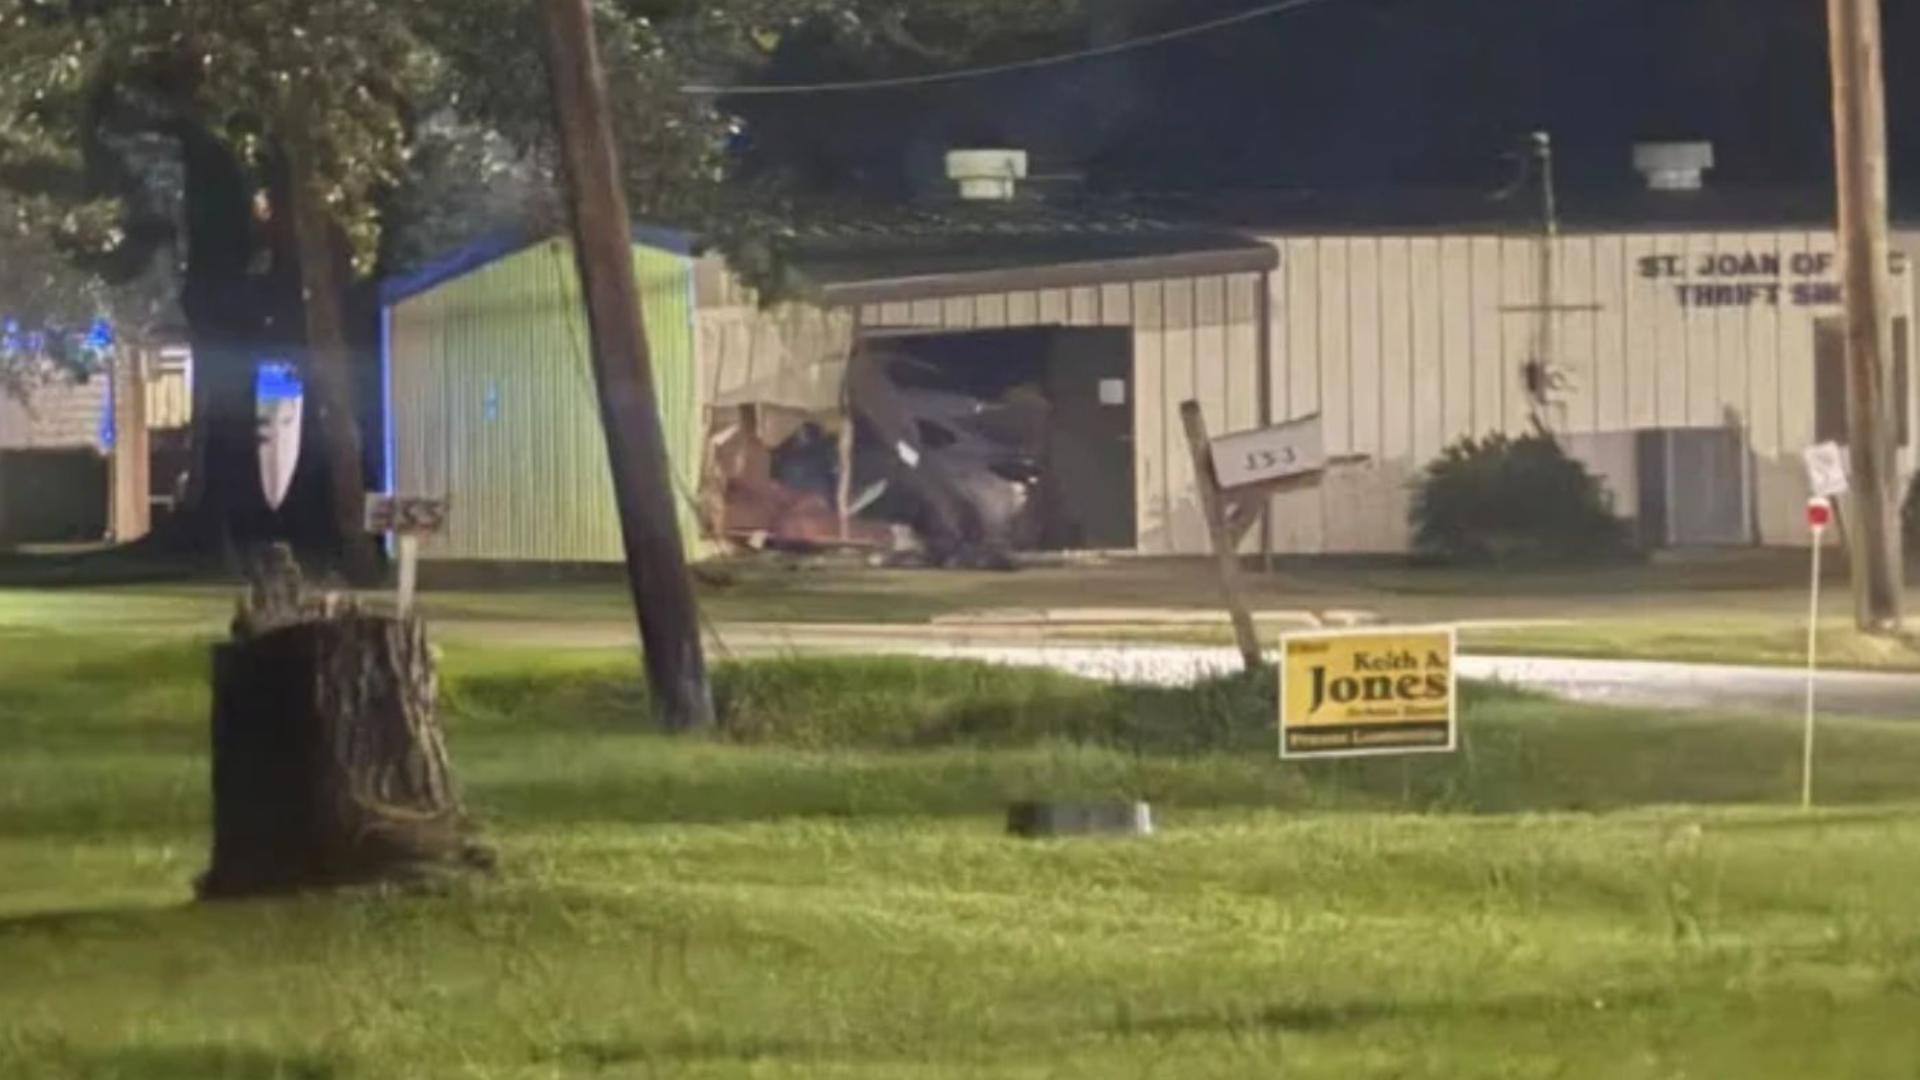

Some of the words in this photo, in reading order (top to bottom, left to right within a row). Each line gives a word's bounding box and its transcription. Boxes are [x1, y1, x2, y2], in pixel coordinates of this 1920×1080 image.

[1697, 251, 1780, 276] JOAN
[1790, 252, 1833, 276] OF
[1674, 283, 1780, 307] THRIFT
[1353, 650, 1418, 672] Keith
[1309, 667, 1448, 714] Jones
